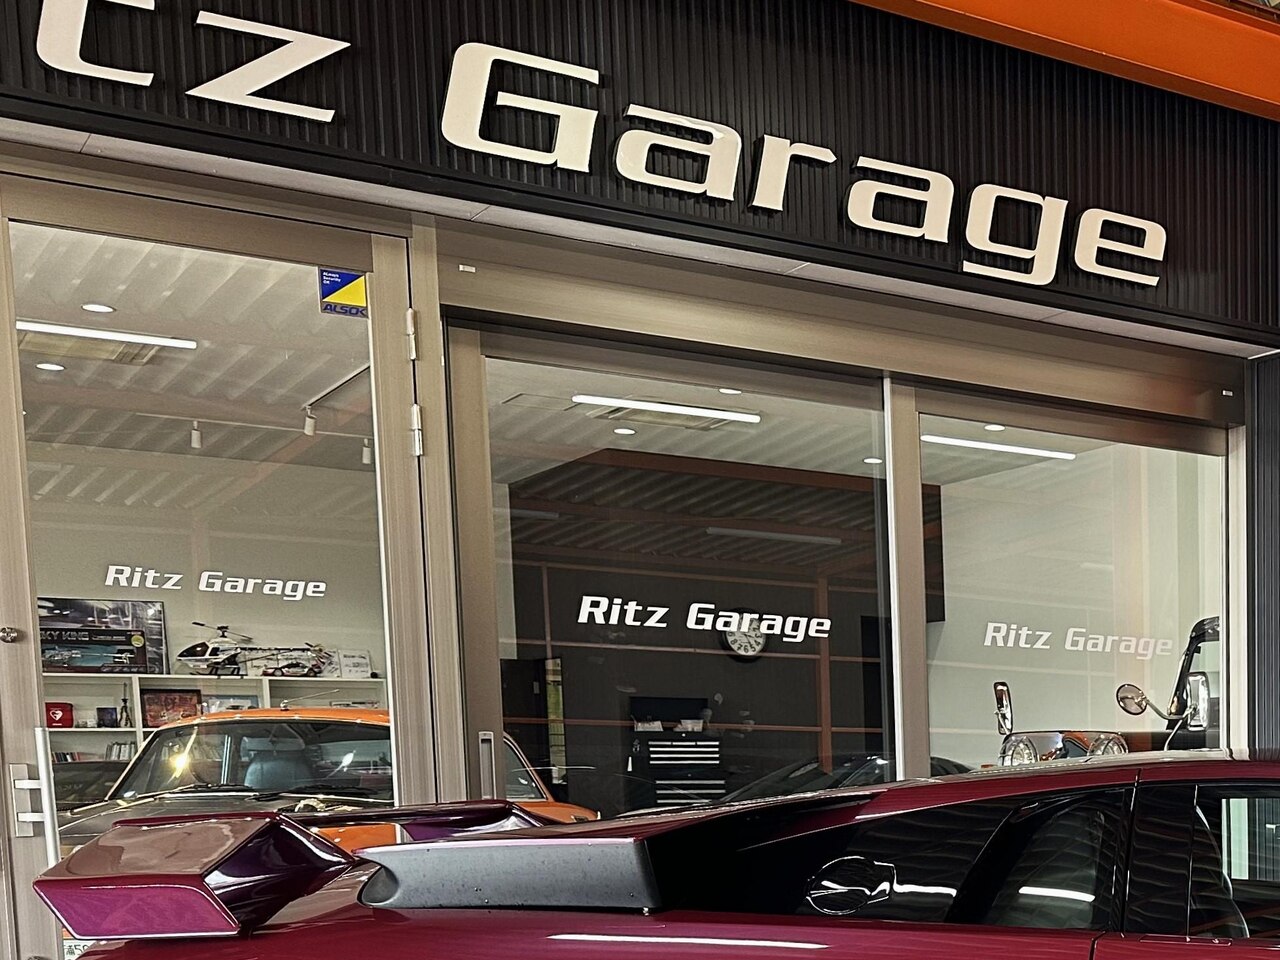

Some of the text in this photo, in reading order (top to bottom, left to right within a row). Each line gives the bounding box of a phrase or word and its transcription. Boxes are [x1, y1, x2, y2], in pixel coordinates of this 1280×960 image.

[441, 42, 1167, 286] Garage
[323, 303, 368, 317] ALSOK
[105, 565, 327, 601] Ritz Garage
[577, 595, 832, 643] Ritz Garage
[984, 622, 1173, 660] Ritz Garage
